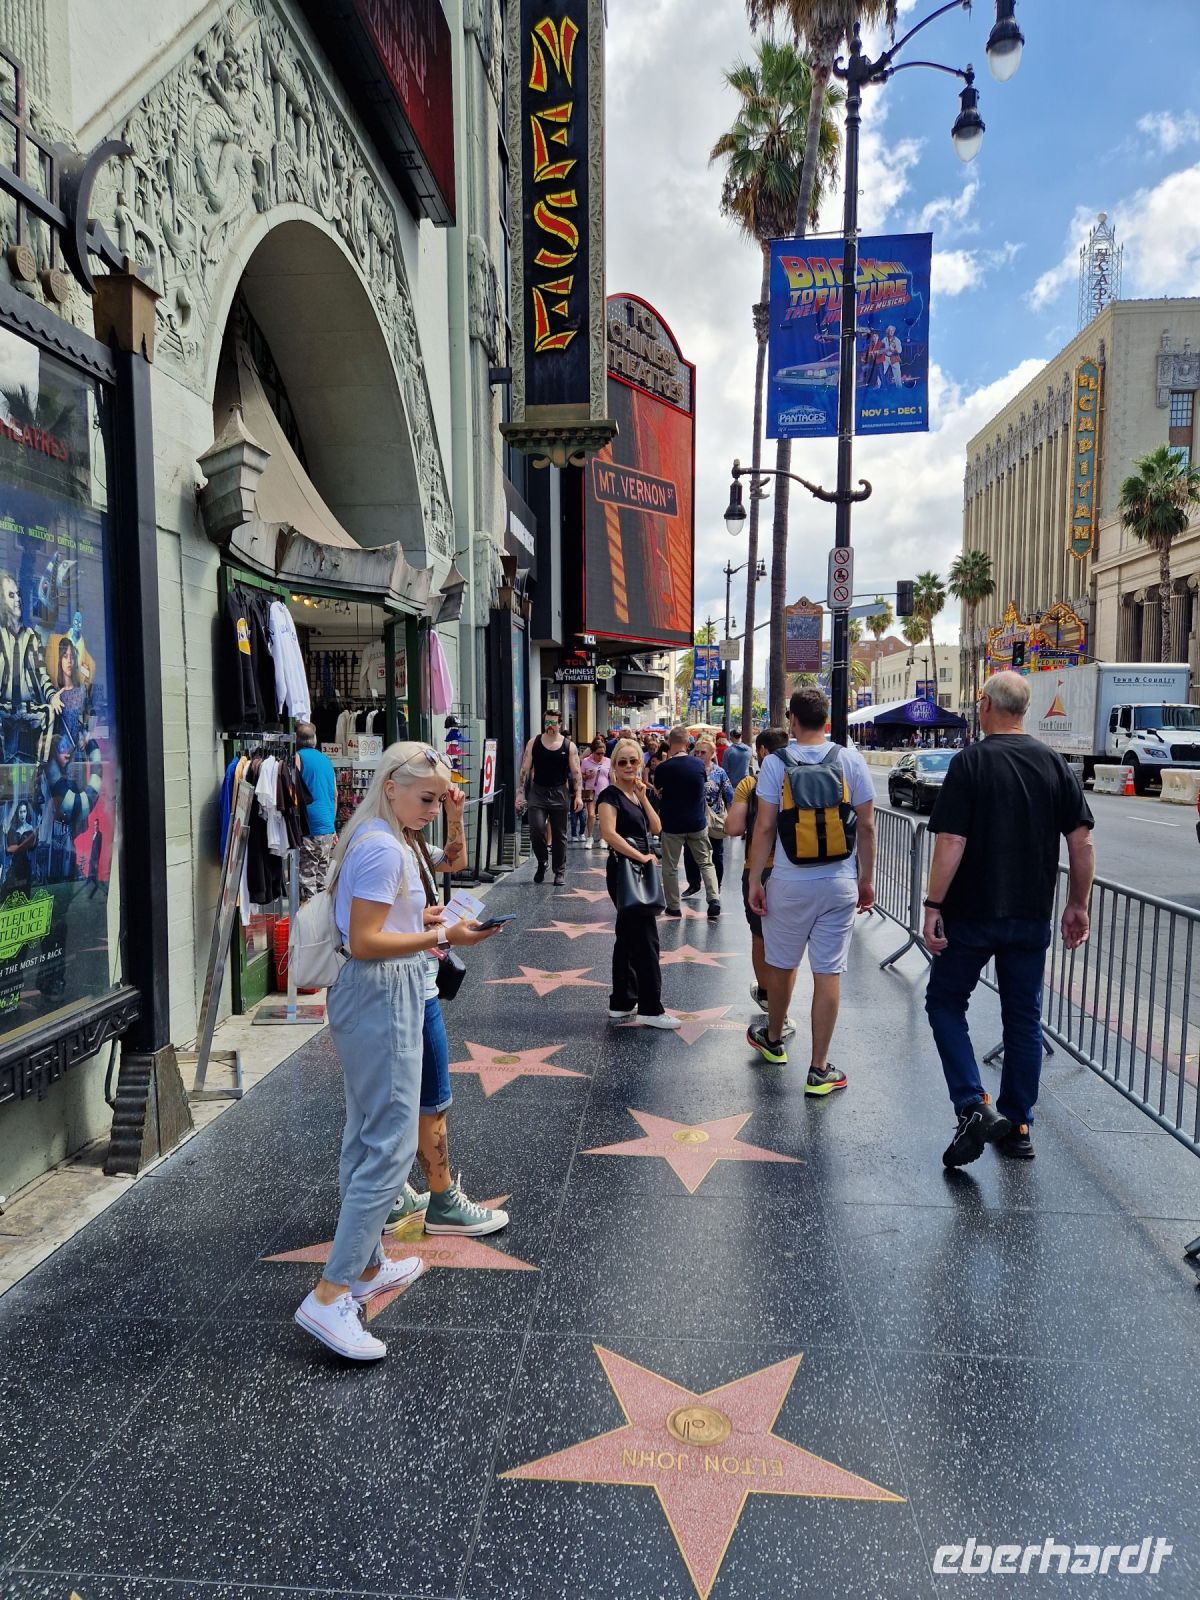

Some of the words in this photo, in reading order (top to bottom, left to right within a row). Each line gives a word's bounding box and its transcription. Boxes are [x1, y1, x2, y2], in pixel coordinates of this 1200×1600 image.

[790, 289, 814, 306] TO
[859, 303, 874, 314] THE
[608, 319, 679, 377] CHINESE
[1078, 373, 1098, 391] EL
[780, 413, 825, 423] PANTAGES
[861, 408, 881, 417] NOV
[883, 408, 890, 416] 5
[897, 406, 916, 415] DEC
[918, 405, 922, 414] 1
[1073, 394, 1095, 540] CAPITAN
[598, 469, 620, 497] MT.
[620, 475, 667, 507] VERNON
[584, 634, 597, 644] TCL
[1142, 676, 1175, 684] Country
[19, 957, 41, 971] MOST
[622, 1450, 689, 1471] JOHN
[705, 1455, 784, 1477] ELTON
